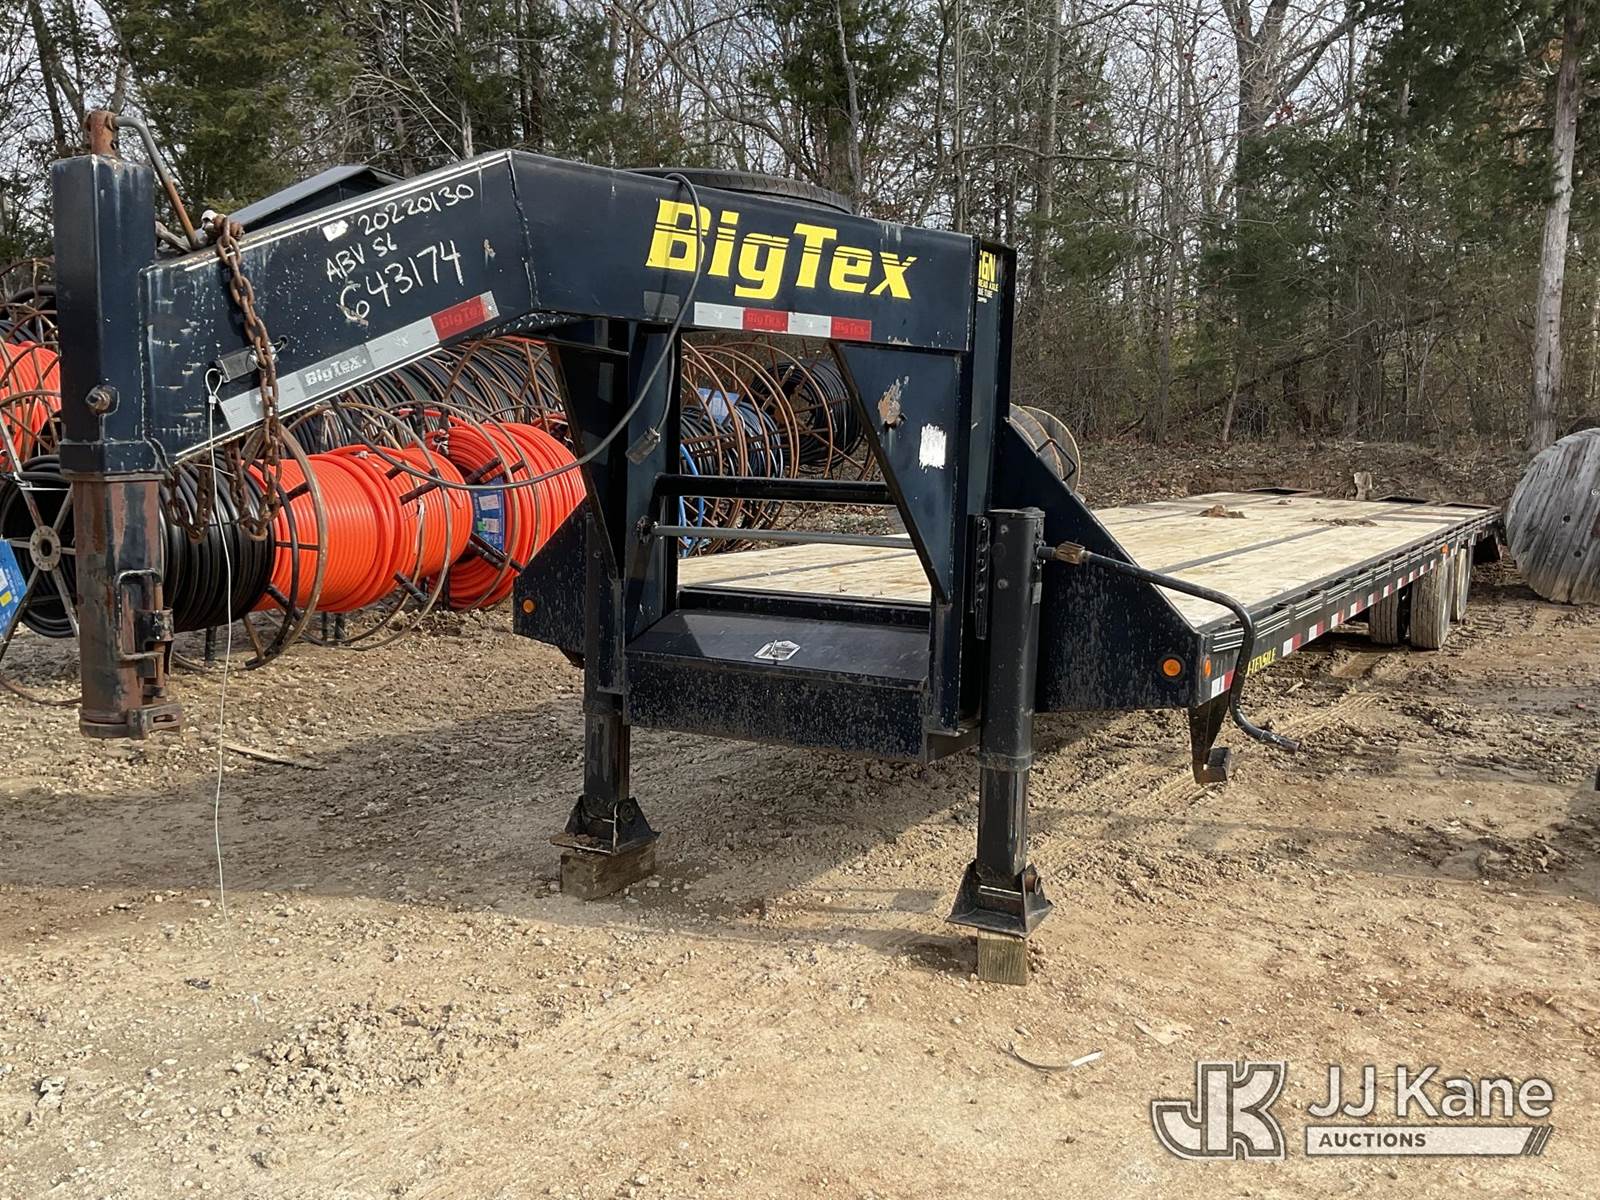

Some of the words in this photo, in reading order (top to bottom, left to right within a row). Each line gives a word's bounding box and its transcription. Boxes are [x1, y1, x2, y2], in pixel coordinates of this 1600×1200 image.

[358, 184, 474, 235] 20220130
[325, 242, 366, 283] ABV
[645, 198, 917, 300] BigTex
[339, 240, 464, 323] 643174
[304, 356, 364, 386] BigTex
